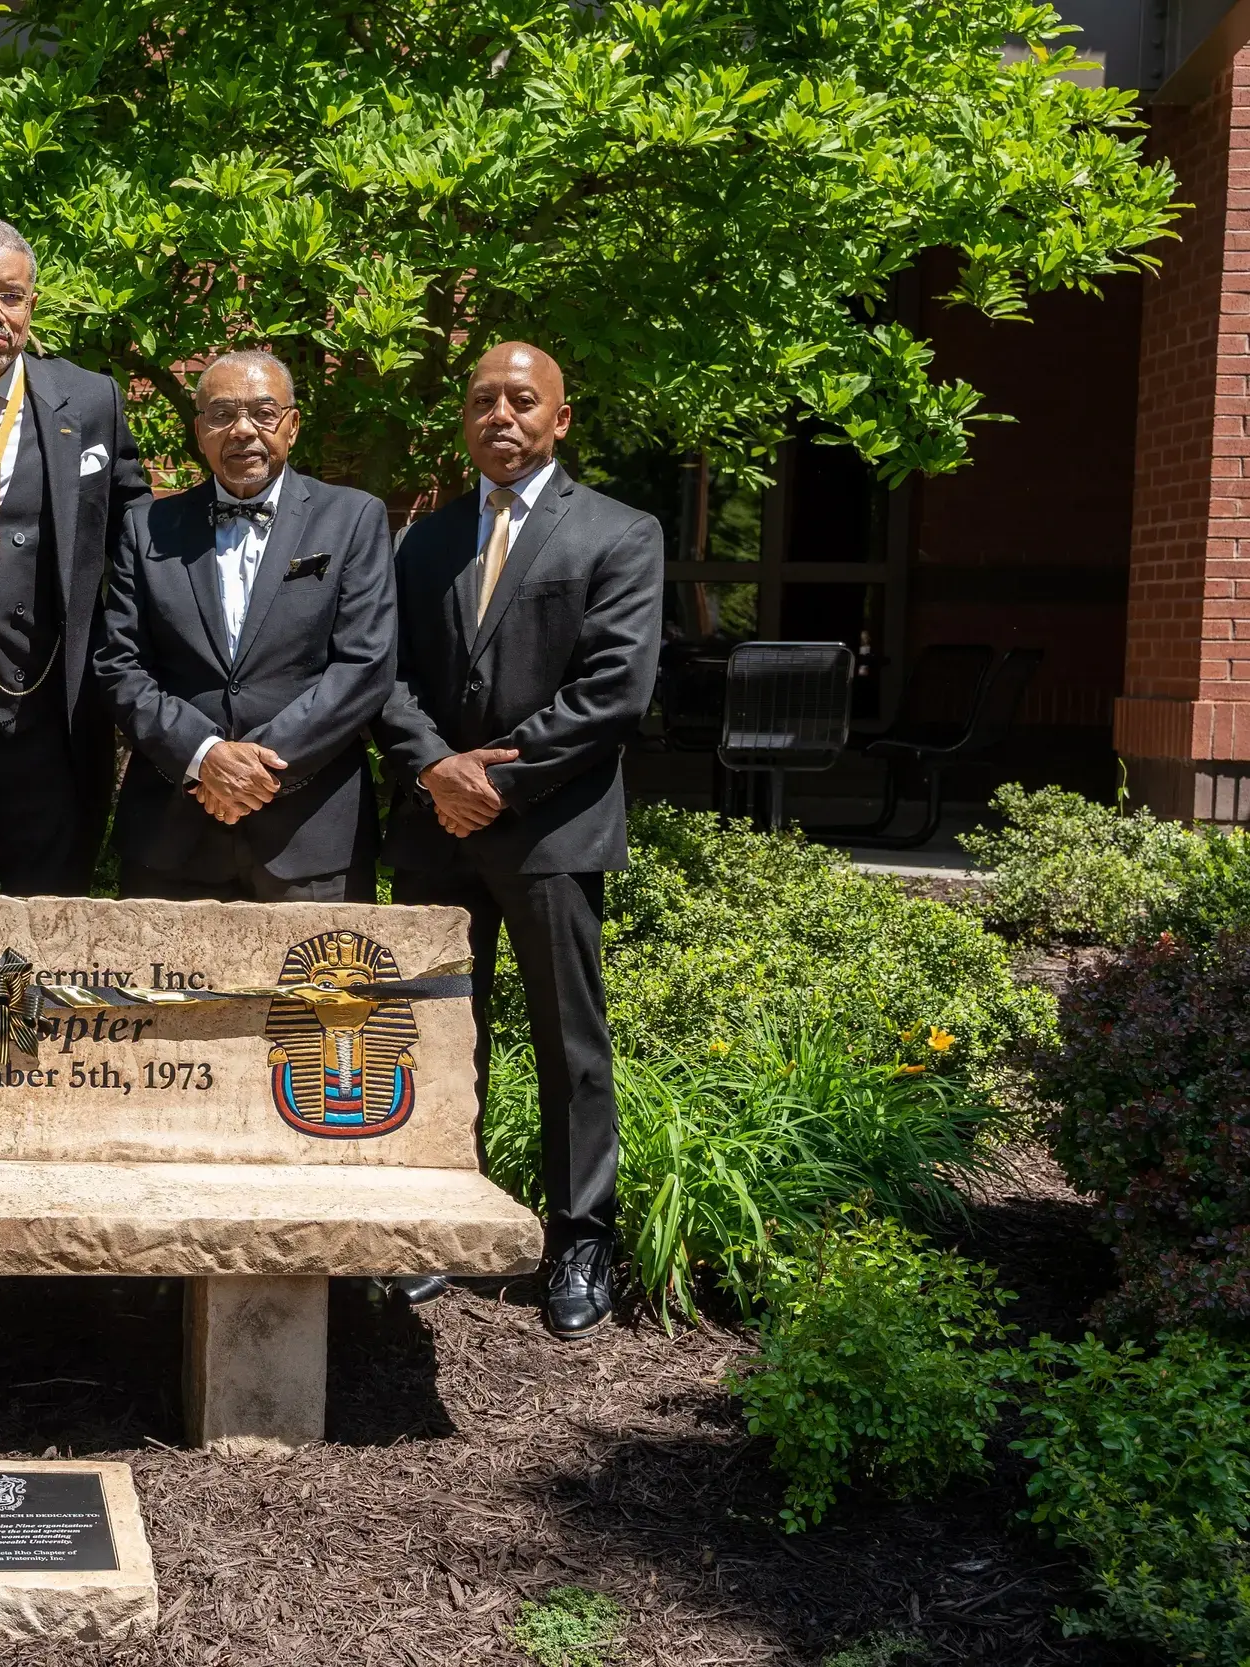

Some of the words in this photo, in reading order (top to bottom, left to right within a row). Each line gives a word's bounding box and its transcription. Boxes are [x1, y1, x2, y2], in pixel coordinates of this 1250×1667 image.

[150, 963, 213, 990] Inc.
[36, 1009, 154, 1055] apter
[69, 1061, 131, 1095] 5th,
[143, 1061, 213, 1091] 1973
